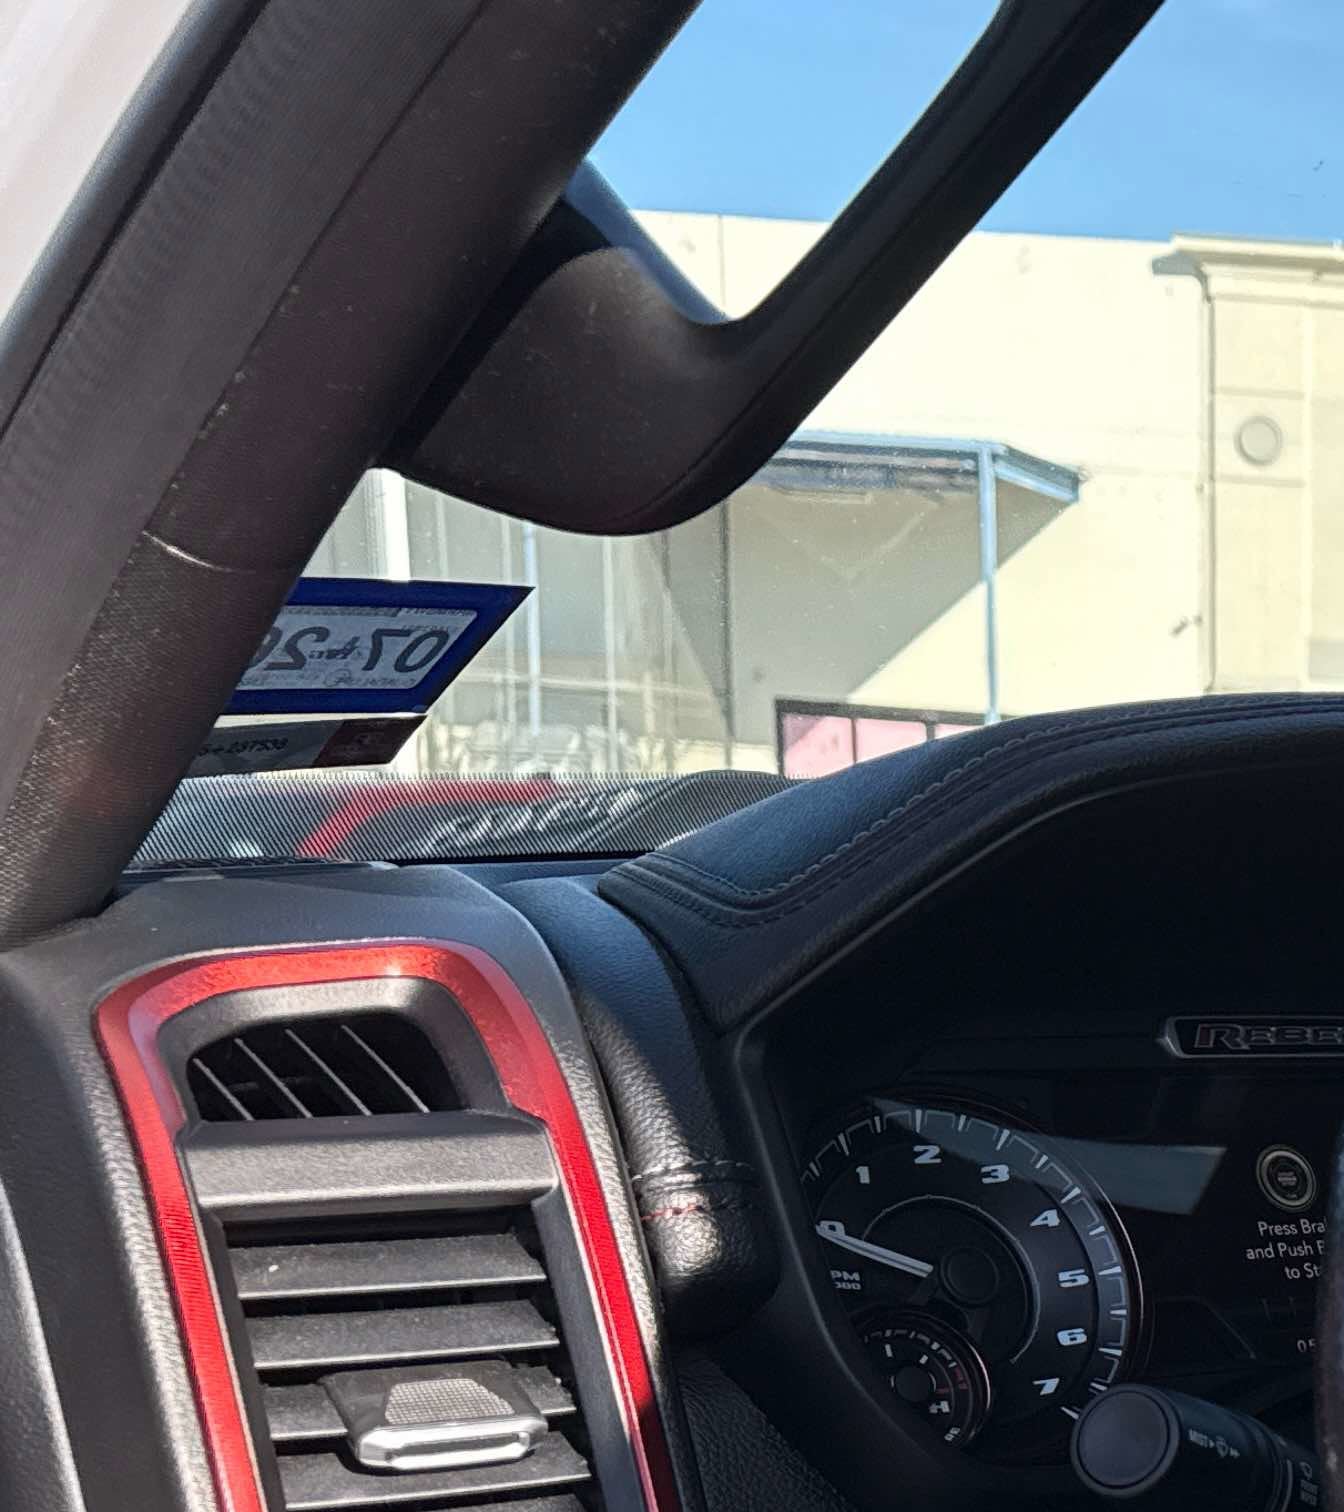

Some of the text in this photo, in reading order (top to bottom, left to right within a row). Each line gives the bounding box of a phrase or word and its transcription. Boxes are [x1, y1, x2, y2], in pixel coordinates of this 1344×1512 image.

[912, 1144, 943, 1165] 2
[855, 1165, 872, 1185] 1
[979, 1163, 1011, 1184] 3
[1029, 1208, 1061, 1228] 4
[1257, 1220, 1298, 1238] Press
[1246, 1241, 1275, 1260] and
[1277, 1240, 1314, 1258] Push
[1056, 1268, 1090, 1288] 5
[1284, 1266, 1300, 1279] to
[1056, 1328, 1088, 1347] 6
[1032, 1377, 1060, 1396] 7
